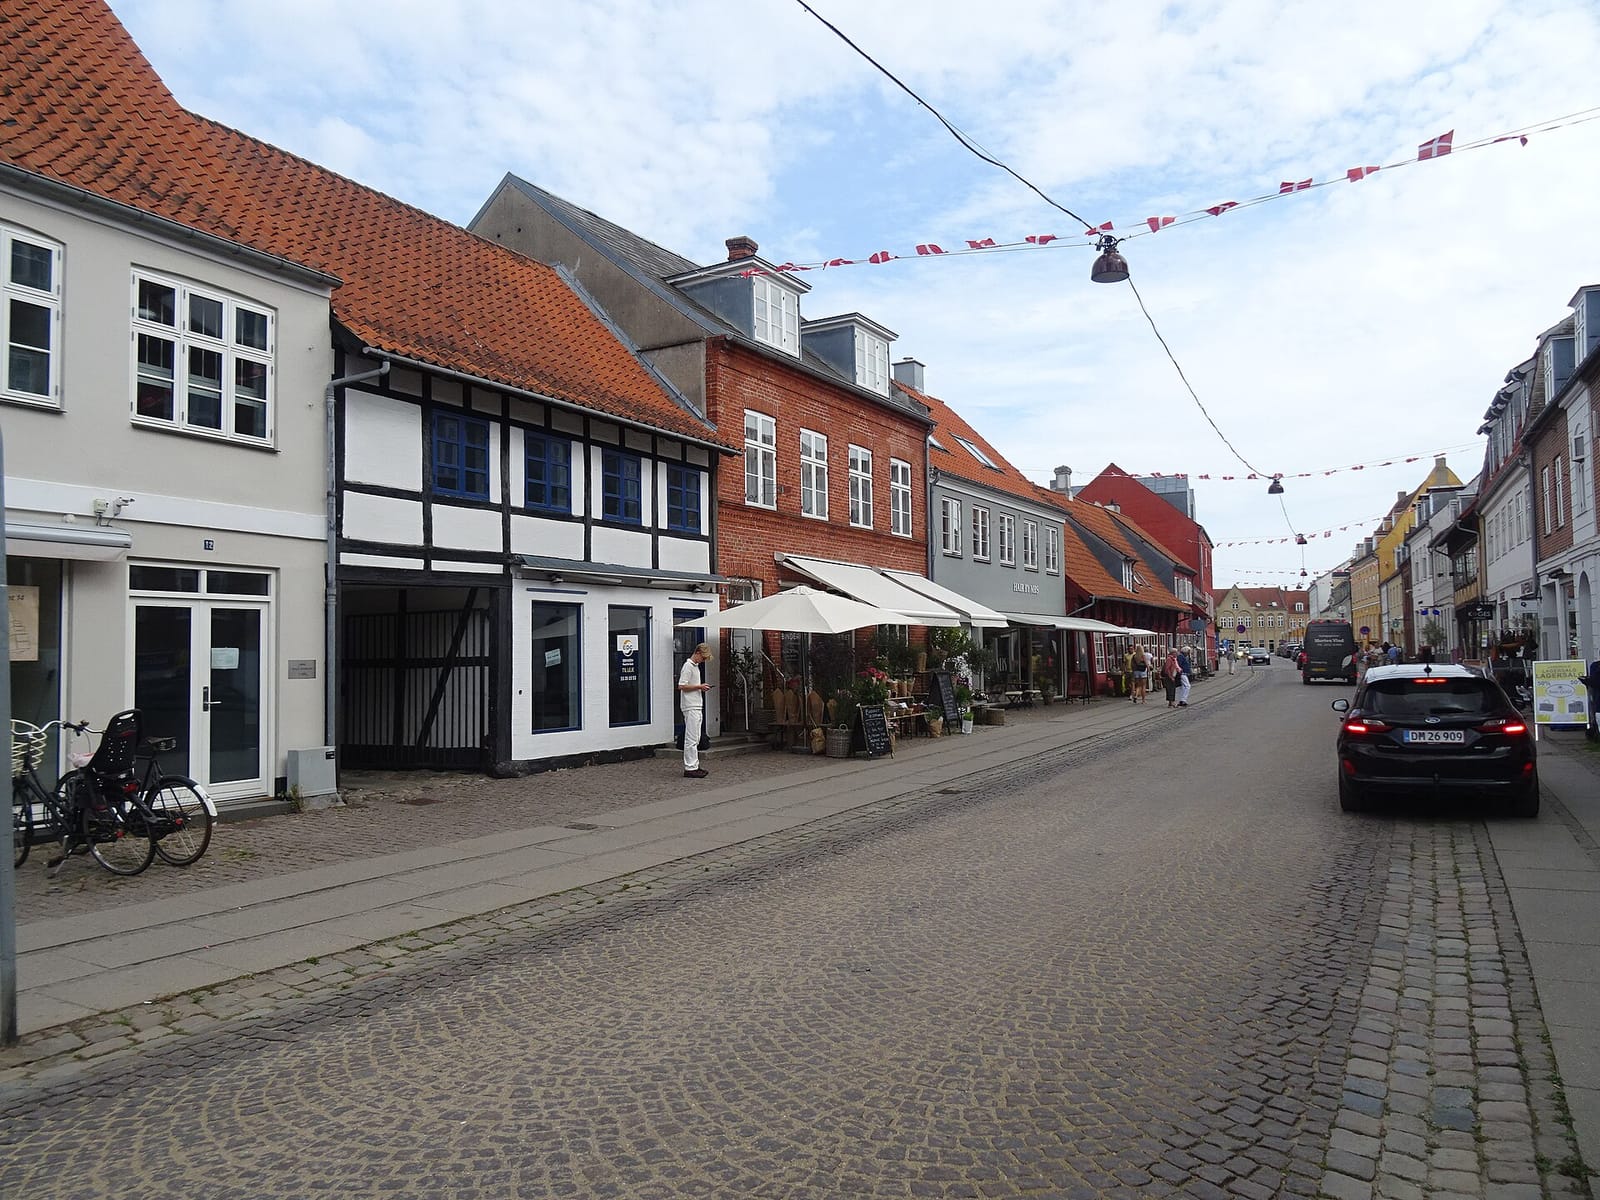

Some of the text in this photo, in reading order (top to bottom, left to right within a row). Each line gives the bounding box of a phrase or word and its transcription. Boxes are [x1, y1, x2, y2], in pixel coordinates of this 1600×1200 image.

[205, 541, 214, 549] 12
[1410, 731, 1463, 741] DM 26 909
